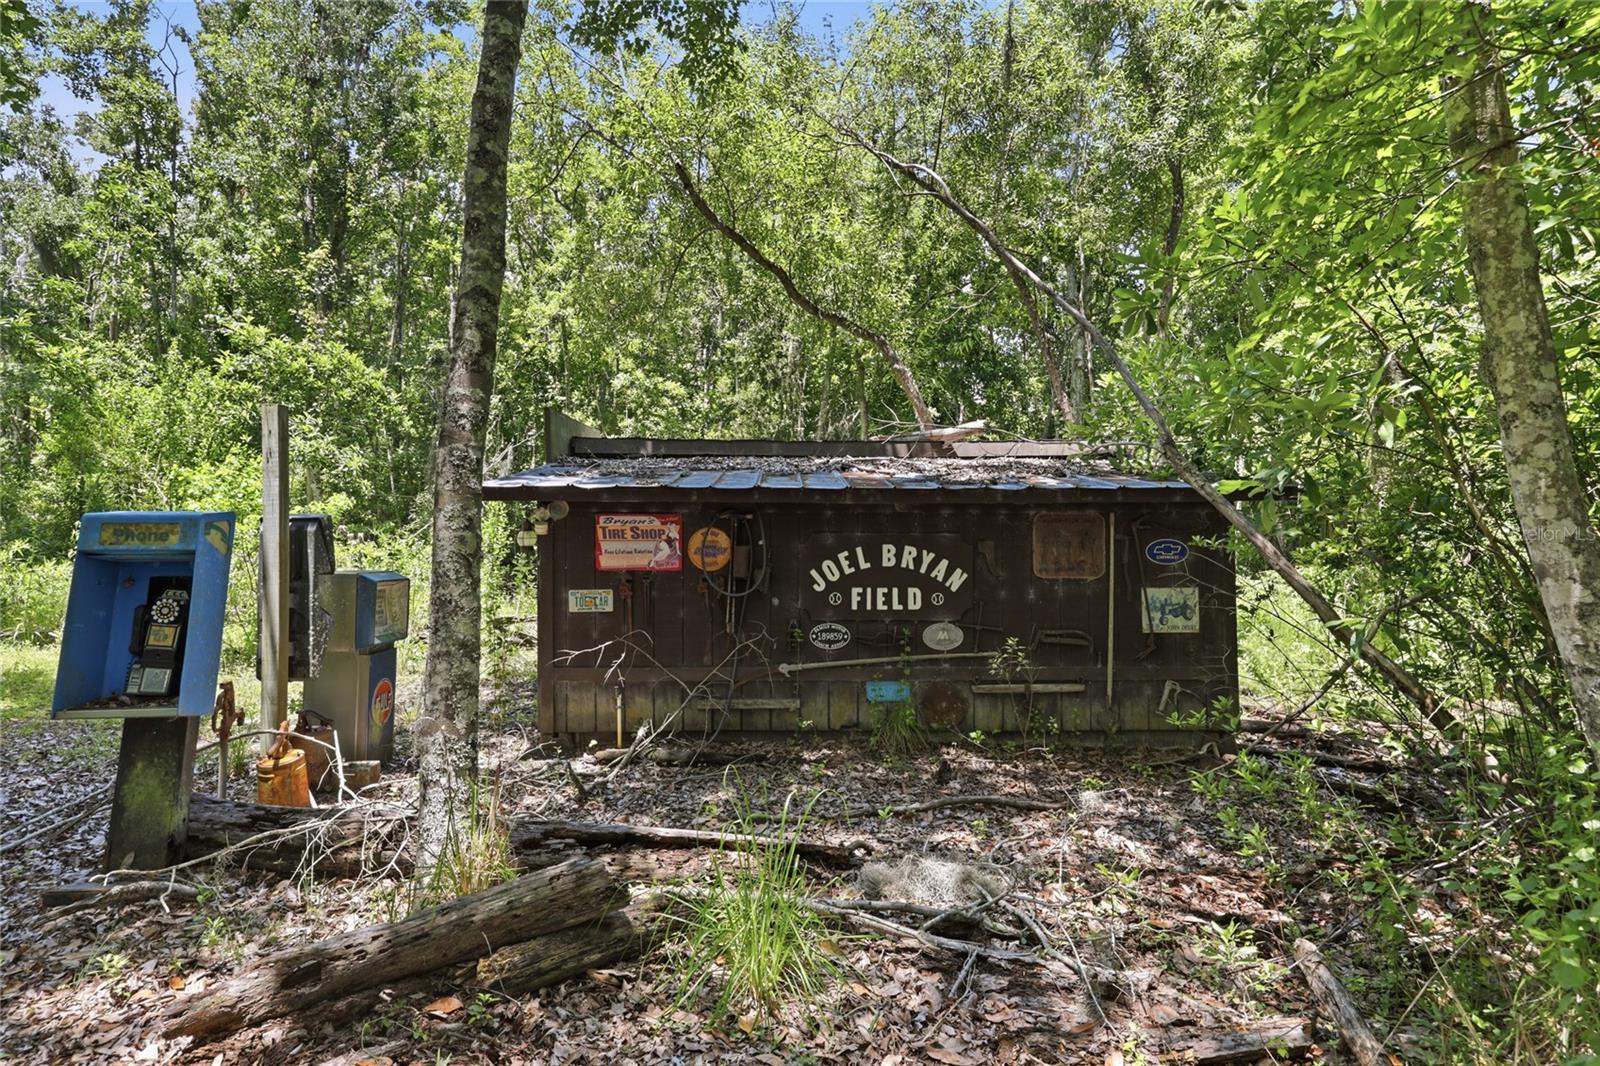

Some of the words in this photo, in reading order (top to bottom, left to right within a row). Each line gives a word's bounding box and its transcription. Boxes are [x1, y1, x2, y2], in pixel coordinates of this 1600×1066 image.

[602, 516, 656, 526] Bryan's
[111, 527, 170, 543] Phone
[599, 526, 628, 540] TIRE
[629, 526, 666, 540] SHOP
[809, 546, 871, 592] JOEL
[881, 544, 969, 593] BRYAN
[851, 587, 922, 610] FIELD
